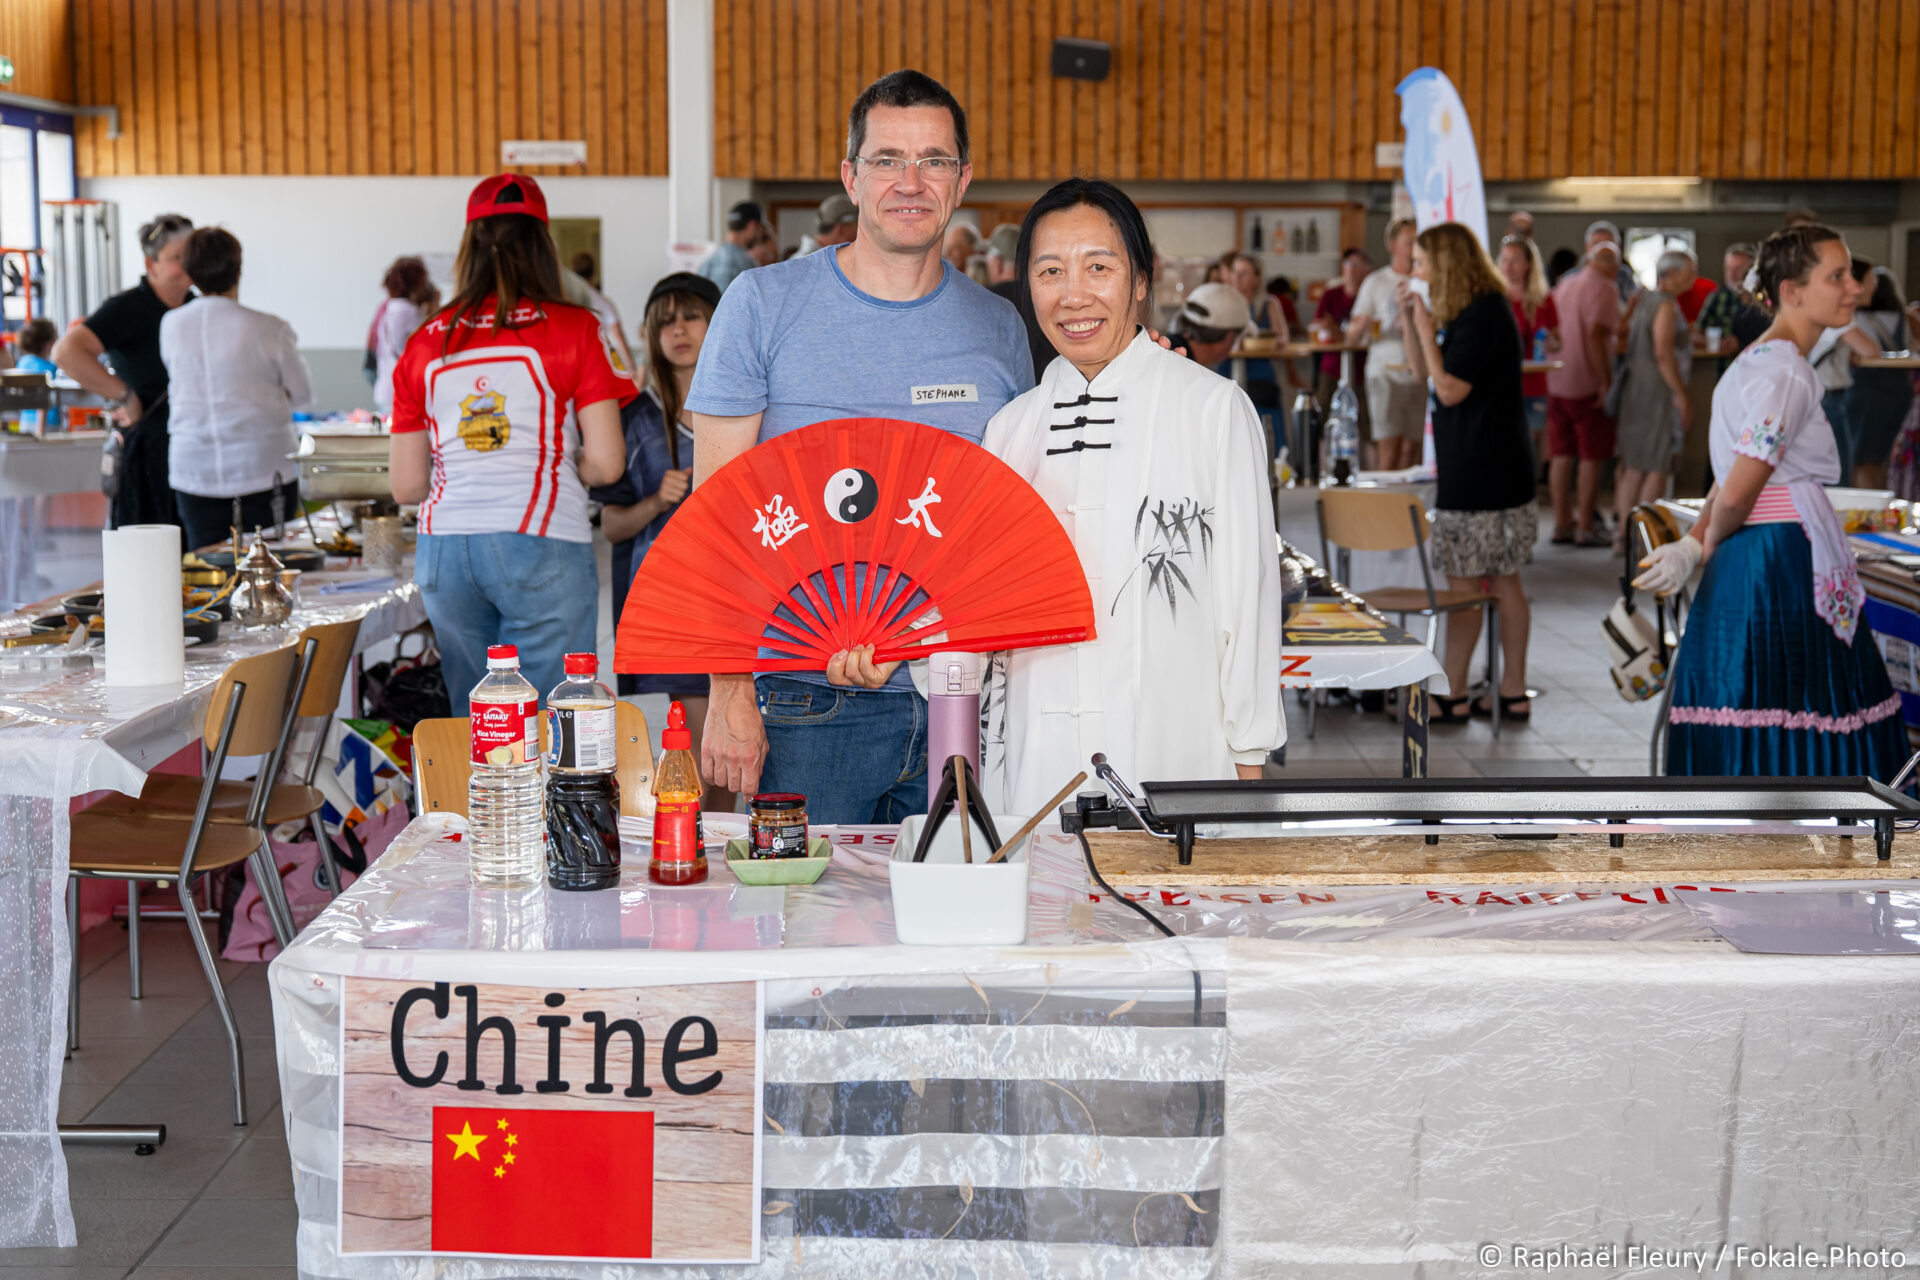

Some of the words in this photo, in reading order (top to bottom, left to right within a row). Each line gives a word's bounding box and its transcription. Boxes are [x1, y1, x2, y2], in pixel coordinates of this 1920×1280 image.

[752, 494, 809, 551] 極
[894, 477, 943, 538] 太
[483, 713, 508, 721] SAITAKU
[490, 731, 516, 739] Vinegar
[391, 981, 723, 1097] Chine
